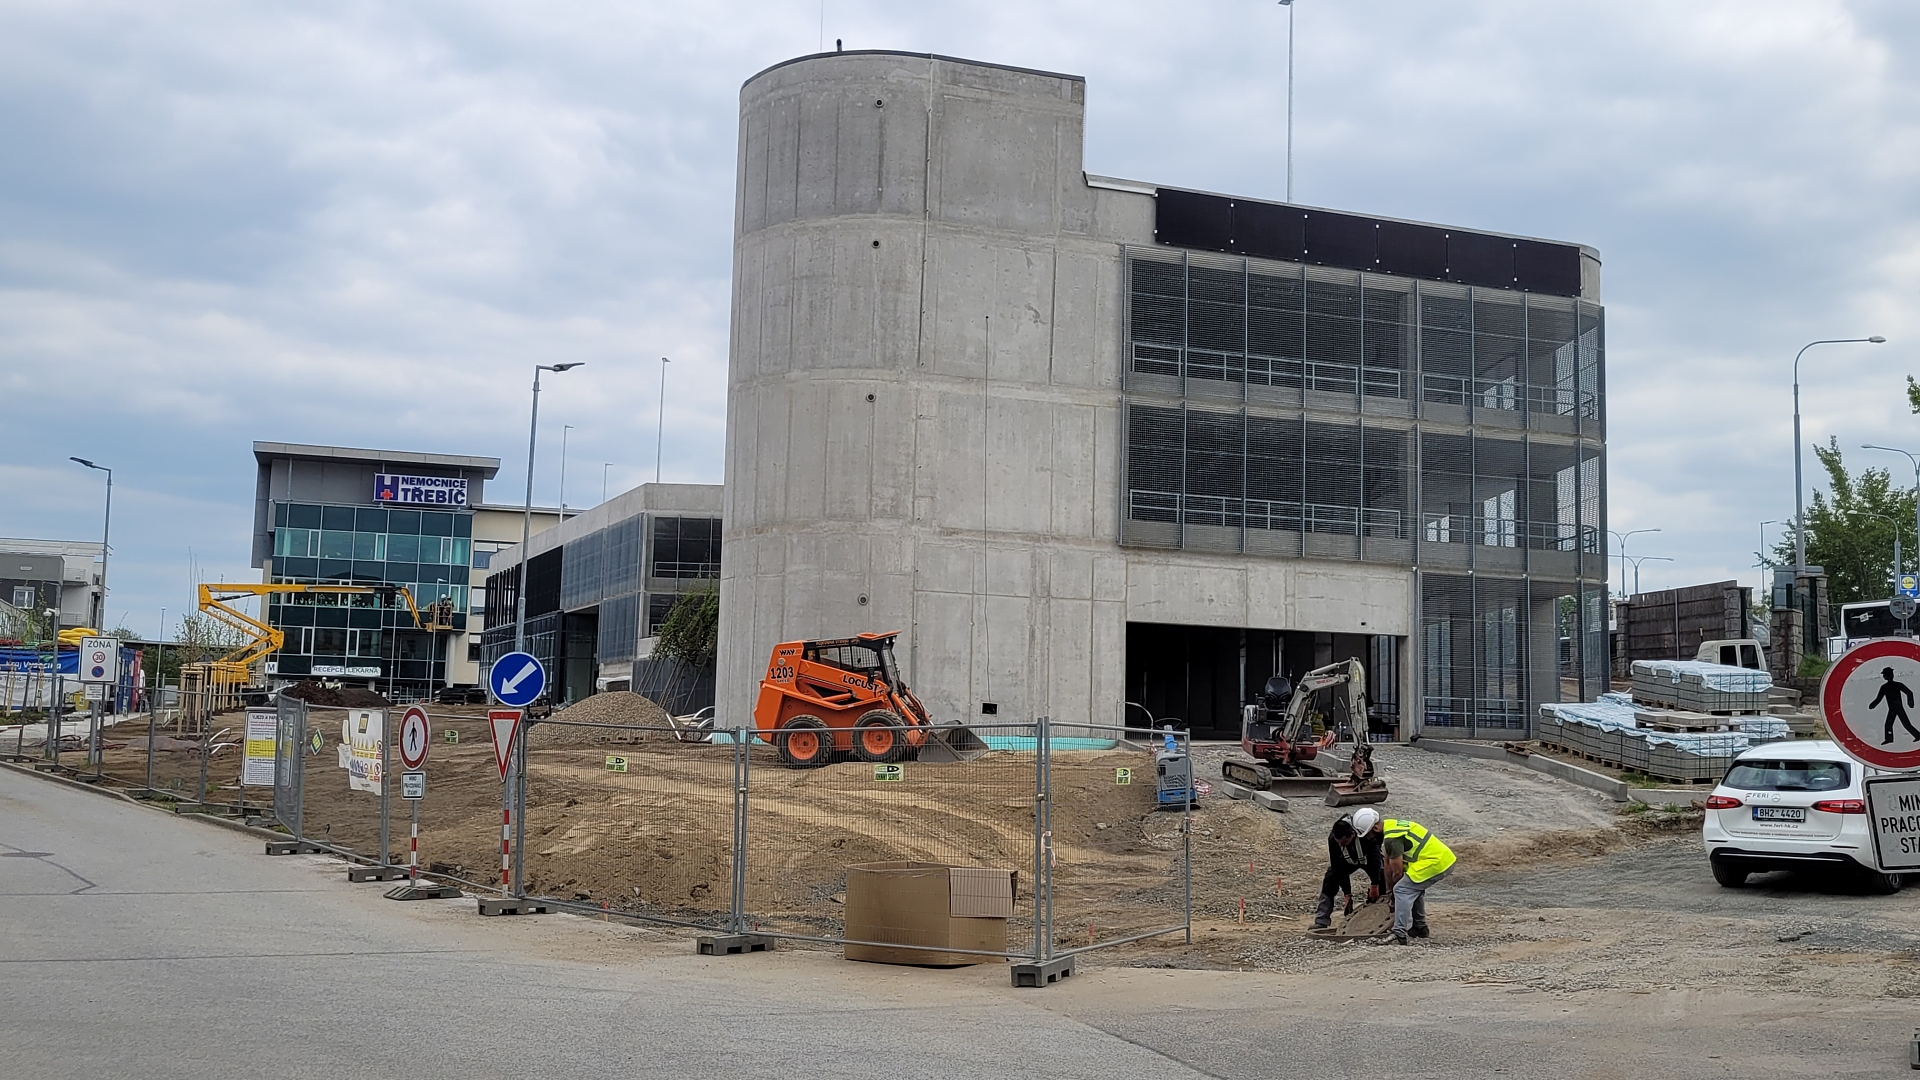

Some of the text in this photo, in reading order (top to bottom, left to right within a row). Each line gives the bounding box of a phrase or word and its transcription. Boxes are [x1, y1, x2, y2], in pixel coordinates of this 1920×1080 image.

[401, 476, 466, 488] NEMOCNICE
[401, 487, 465, 504] TŘEBÍČ
[770, 666, 794, 679] 1203
[842, 674, 879, 693] LOCUST
[1759, 808, 1801, 818] 8H2 4420
[1900, 836, 1920, 854] ST
